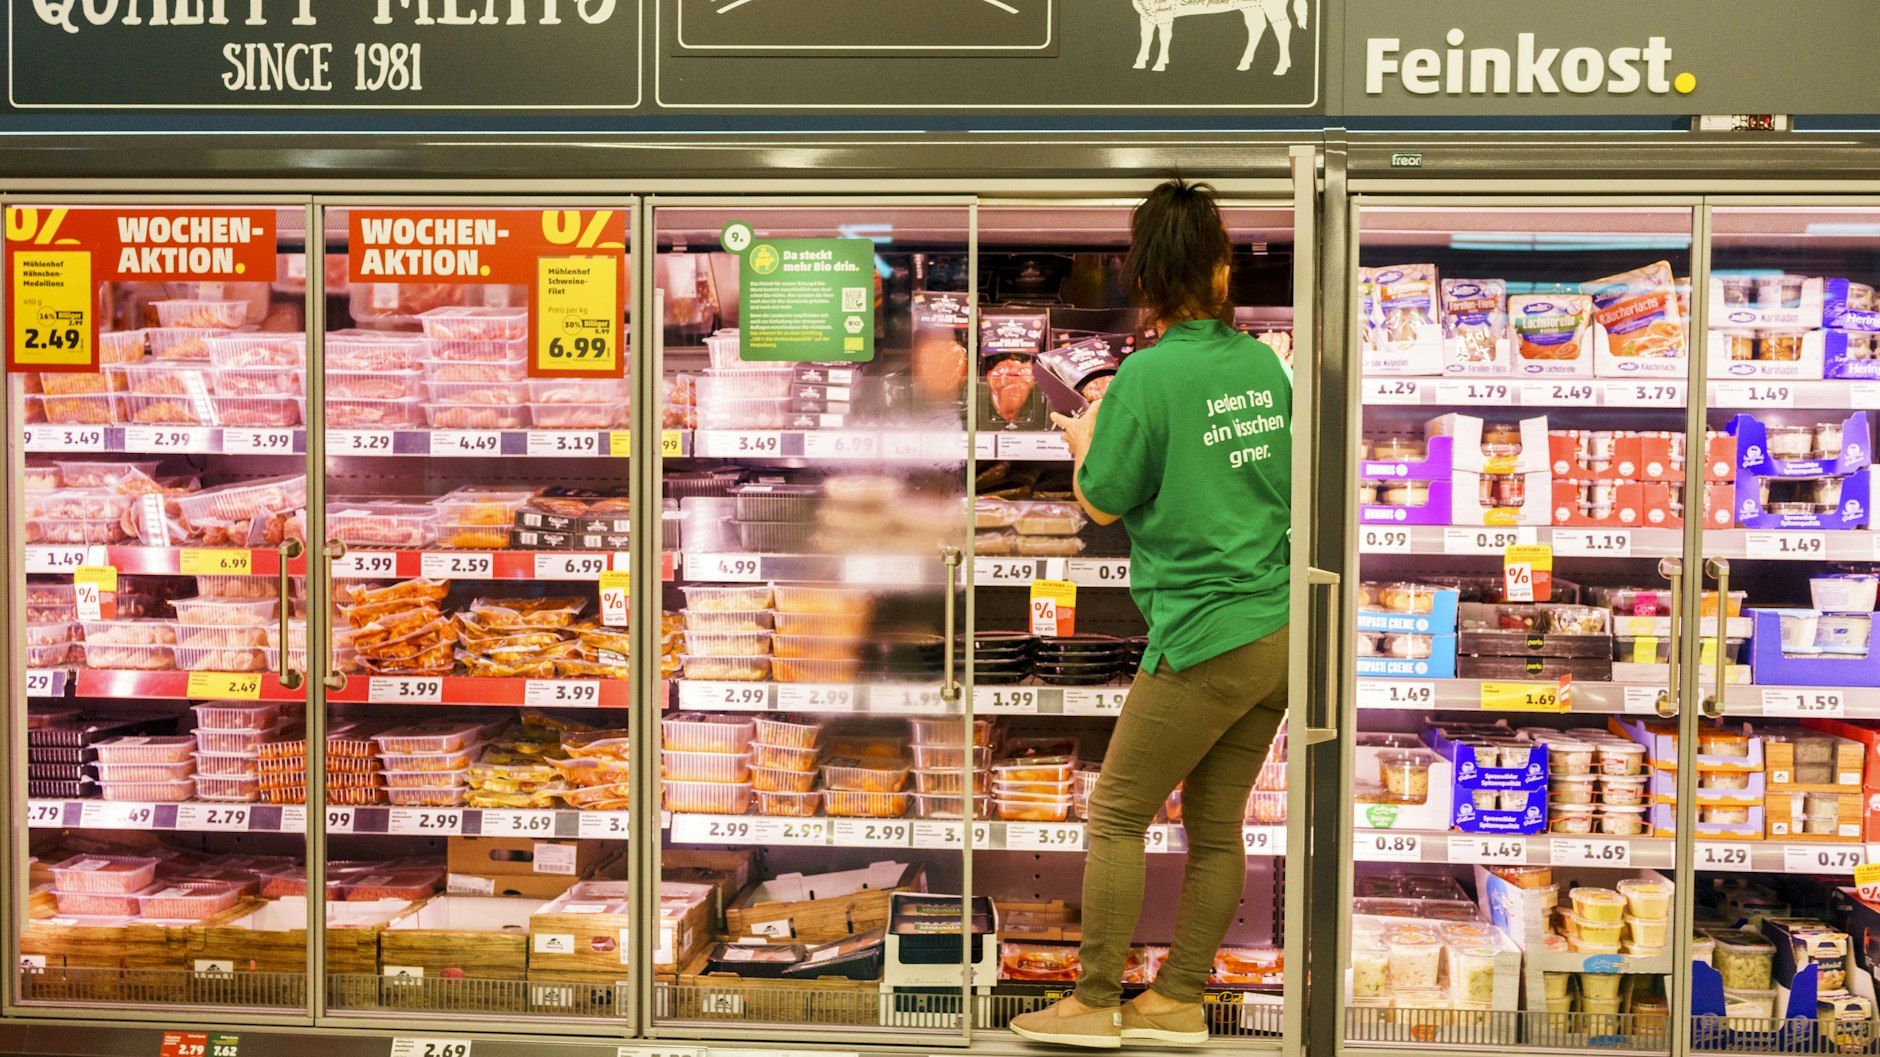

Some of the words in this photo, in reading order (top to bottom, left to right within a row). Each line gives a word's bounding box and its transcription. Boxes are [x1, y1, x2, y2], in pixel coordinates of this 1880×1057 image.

[221, 43, 332, 91] SINCE
[354, 43, 423, 91] 1981
[1366, 28, 1697, 94] Feinkost.
[117, 216, 264, 244] WOCHEN-
[361, 218, 510, 245] WOCHEN-
[731, 232, 744, 243] 9.
[117, 247, 246, 274] AKTION.
[783, 250, 797, 260] Da
[799, 250, 833, 260] steckt
[361, 249, 491, 276] AKTION.
[783, 261, 811, 272] mehr
[813, 261, 832, 272] Bio
[834, 260, 860, 272] drin.
[25, 329, 80, 349] 2.49
[549, 337, 606, 358] 6.99
[1246, 390, 1273, 408] Tag
[1468, 385, 1507, 399] 1.79
[1552, 385, 1592, 399] 2.49
[1636, 386, 1676, 400] 3.79
[1748, 387, 1788, 400] 1.49
[64, 431, 100, 444] 3.49
[154, 432, 191, 446] 2.99
[252, 434, 289, 447] 3.99
[352, 435, 390, 449] 3.29
[1203, 424, 1232, 446] ein
[459, 436, 497, 450] 4.49
[556, 436, 594, 450] 3.19
[738, 437, 777, 451] 3.49
[834, 437, 874, 451] 6.99
[1366, 532, 1406, 546] 0.99
[1476, 533, 1517, 547] 0.89
[1585, 535, 1626, 549] 1.19
[1779, 538, 1821, 552] 1.49
[47, 553, 84, 565] 1.49
[220, 558, 247, 569] 6.99
[354, 557, 392, 571] 3.99
[451, 559, 489, 573] 2.59
[565, 560, 603, 573] 6.99
[718, 560, 756, 574] 4.99
[993, 564, 1032, 578] 2.49
[1099, 565, 1128, 580] 0.9
[228, 681, 256, 693] 2.49
[399, 682, 438, 696] 3.99
[555, 686, 594, 700] 3.99
[724, 689, 764, 703] 2.99
[808, 690, 848, 705] 2.99
[902, 692, 941, 706] 1.99
[993, 692, 1033, 707] 1.99
[1095, 694, 1125, 709] 1.9
[1389, 687, 1431, 702] 1.49
[1526, 694, 1556, 705] 1.69
[1796, 695, 1839, 710] 1.59
[207, 810, 245, 824] 2.79
[419, 814, 458, 828] 2.99
[512, 816, 550, 830] 3.69
[709, 822, 749, 837] 2.99
[783, 824, 823, 838] 2.99
[865, 825, 905, 840] 2.99
[945, 827, 985, 842] 3.9
[1039, 829, 1079, 844] 3.99
[1375, 836, 1417, 851] 0.89
[1480, 842, 1522, 857] 1.49
[1584, 845, 1626, 860] 1.69
[1705, 848, 1747, 863] 1.29
[1818, 852, 1860, 867] 0.79
[178, 1043, 205, 1056] 2.79
[213, 1045, 238, 1057] 7.62
[424, 1043, 466, 1057] 2.69
